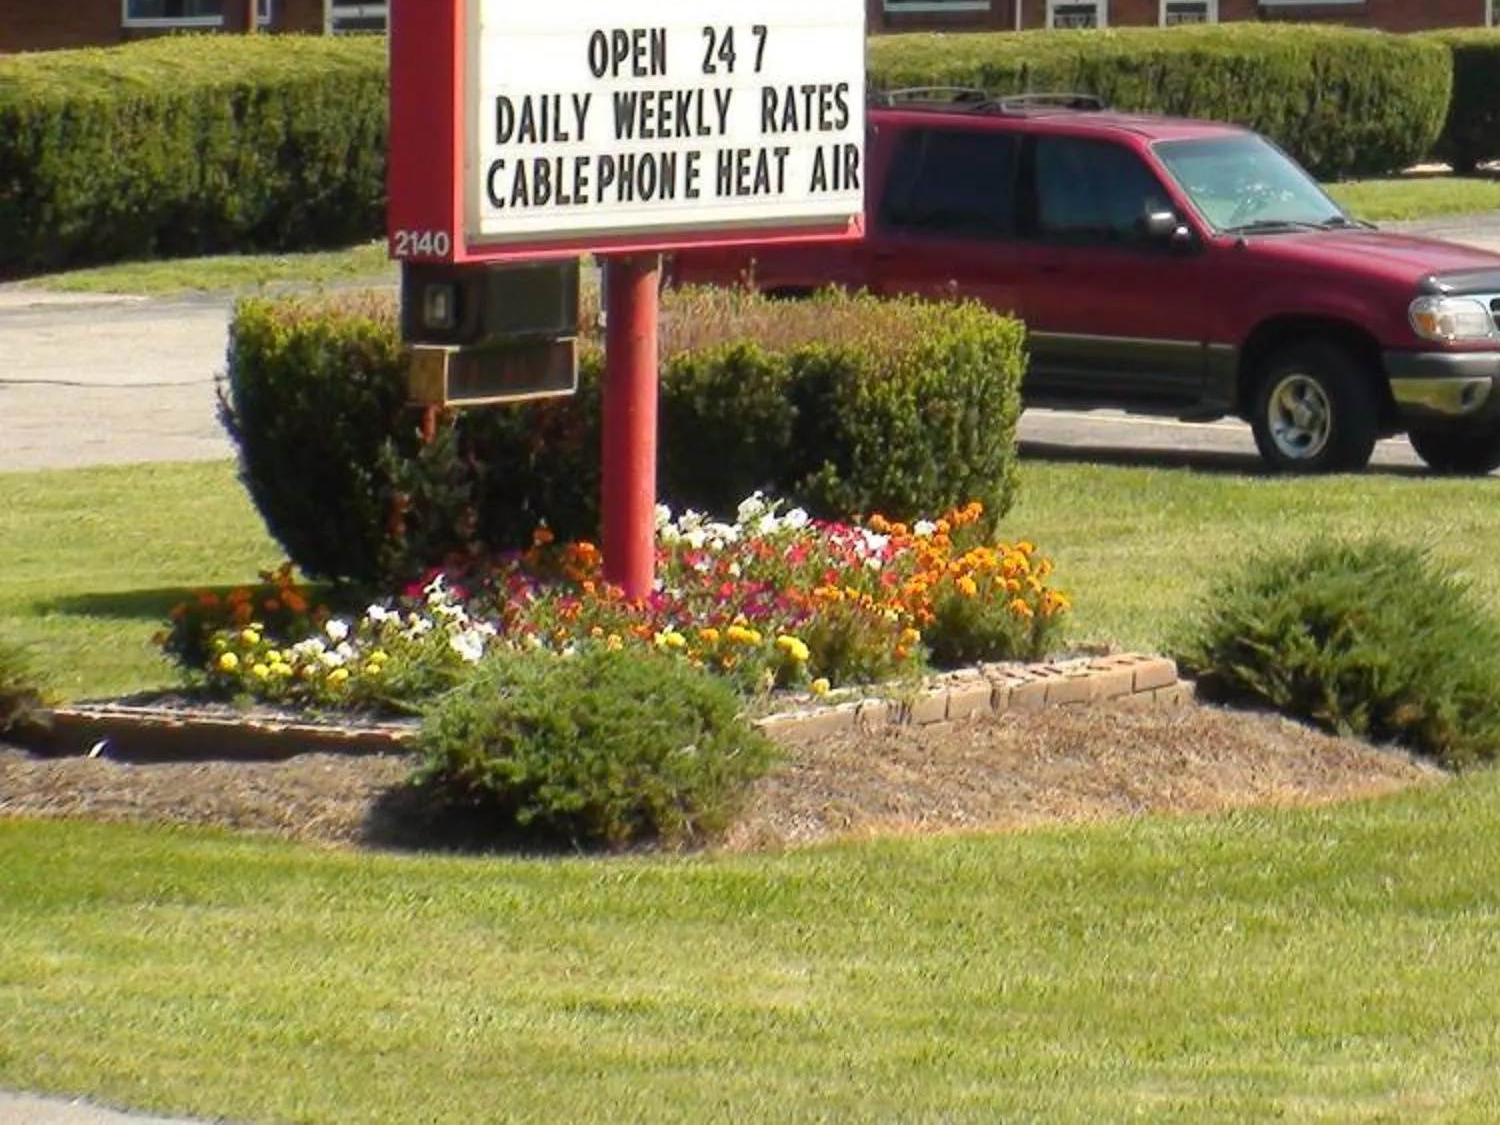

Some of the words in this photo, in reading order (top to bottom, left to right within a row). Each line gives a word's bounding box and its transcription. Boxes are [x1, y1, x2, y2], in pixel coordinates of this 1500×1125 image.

[588, 28, 666, 78] OPEN
[496, 93, 591, 144] DAILY
[614, 88, 732, 139] WEEKLY
[762, 83, 849, 133] RATES
[716, 147, 789, 196] HEAT
[810, 144, 859, 192] AIR
[396, 231, 448, 255] 2140
